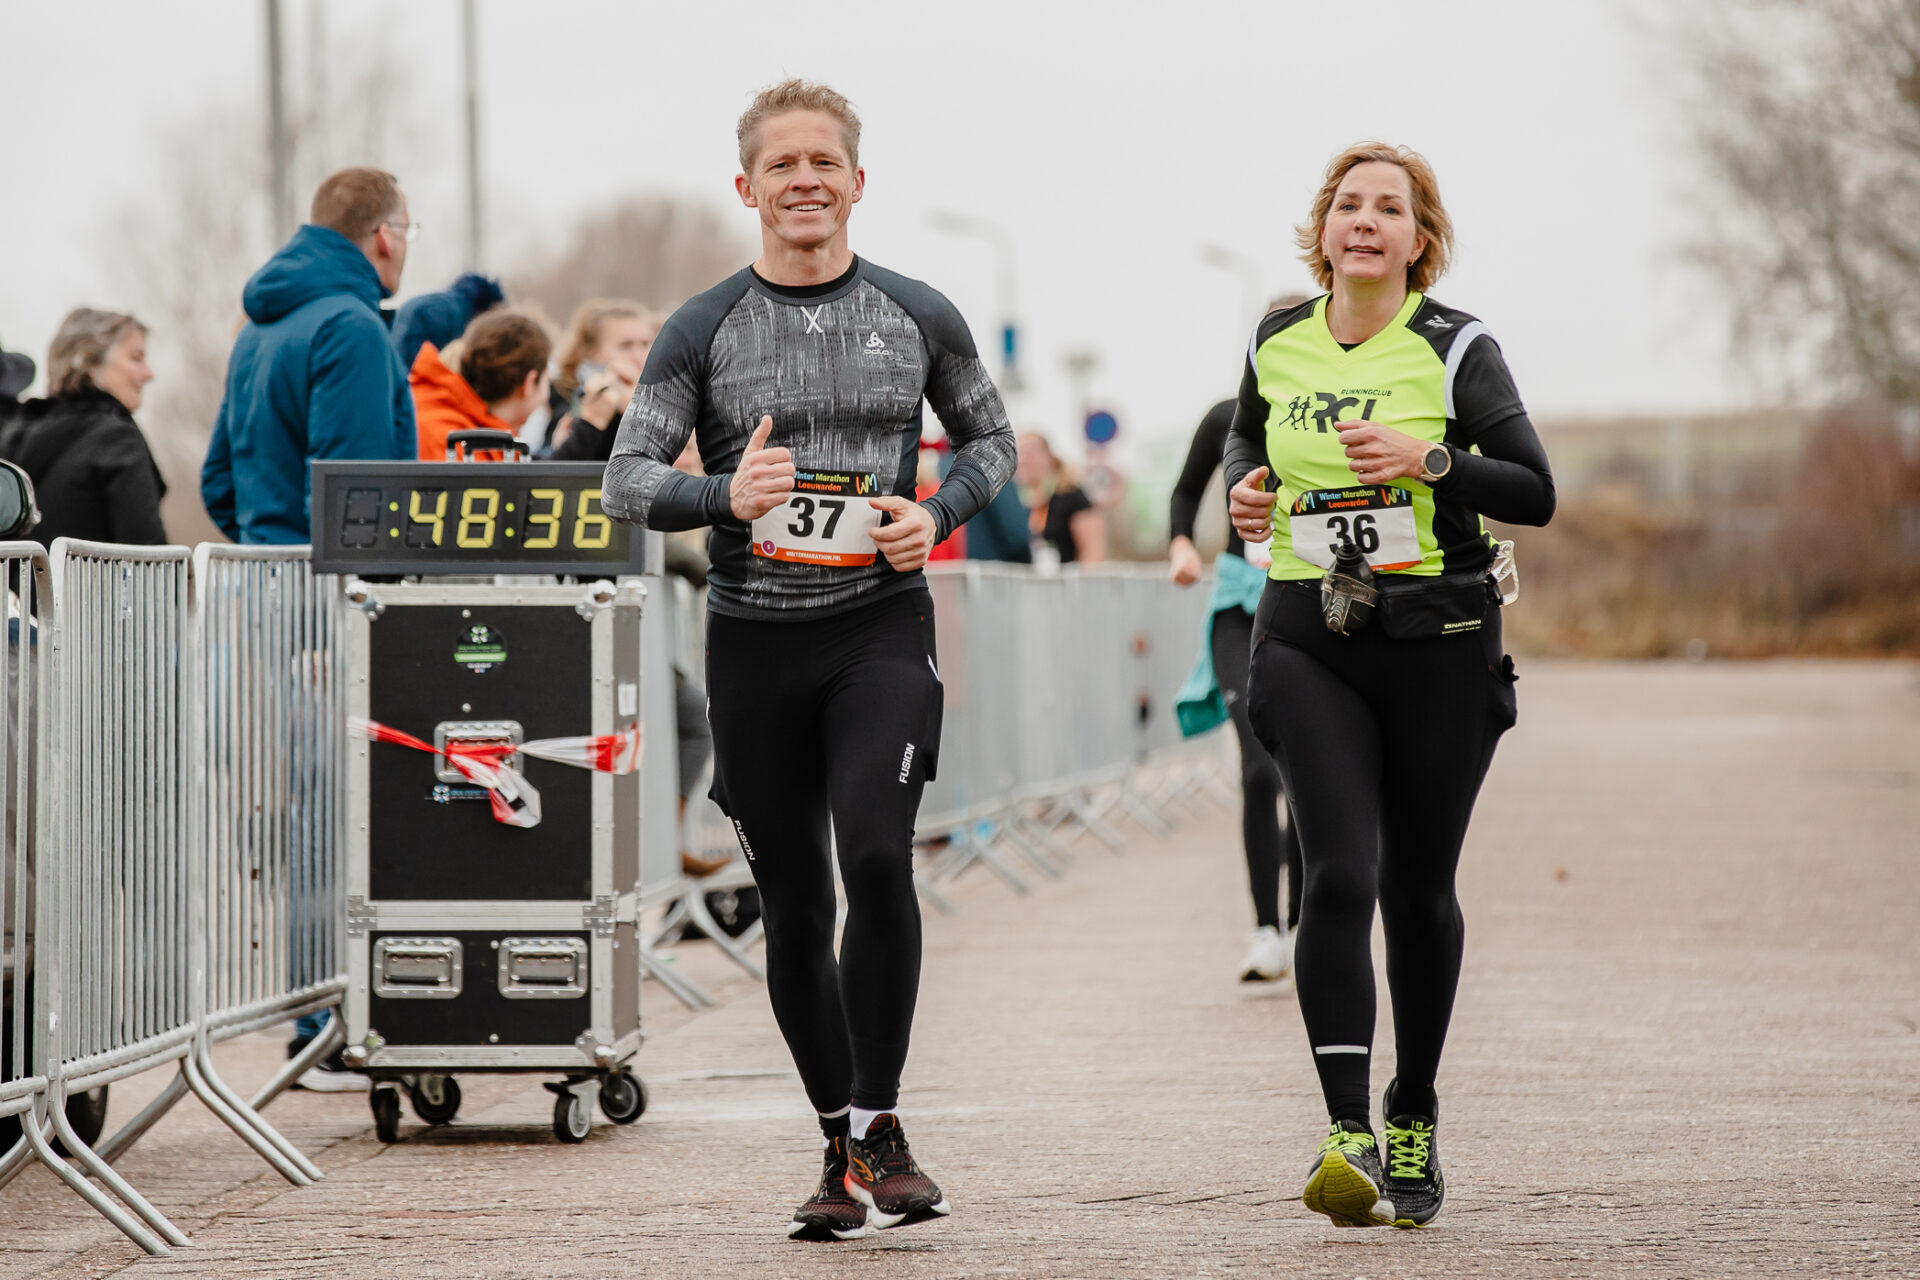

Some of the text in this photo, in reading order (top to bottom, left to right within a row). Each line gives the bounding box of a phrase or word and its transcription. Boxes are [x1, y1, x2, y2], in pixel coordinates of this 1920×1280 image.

[798, 481, 842, 492] Leeuwarden
[816, 473, 850, 483] Marathon
[1319, 489, 1376, 501] Winter Marathon
[1328, 499, 1369, 509] Leeuwarden
[787, 496, 846, 540] 37
[1326, 514, 1380, 555] 36
[899, 742, 915, 784] FUSION
[734, 820, 756, 860] FUSION
